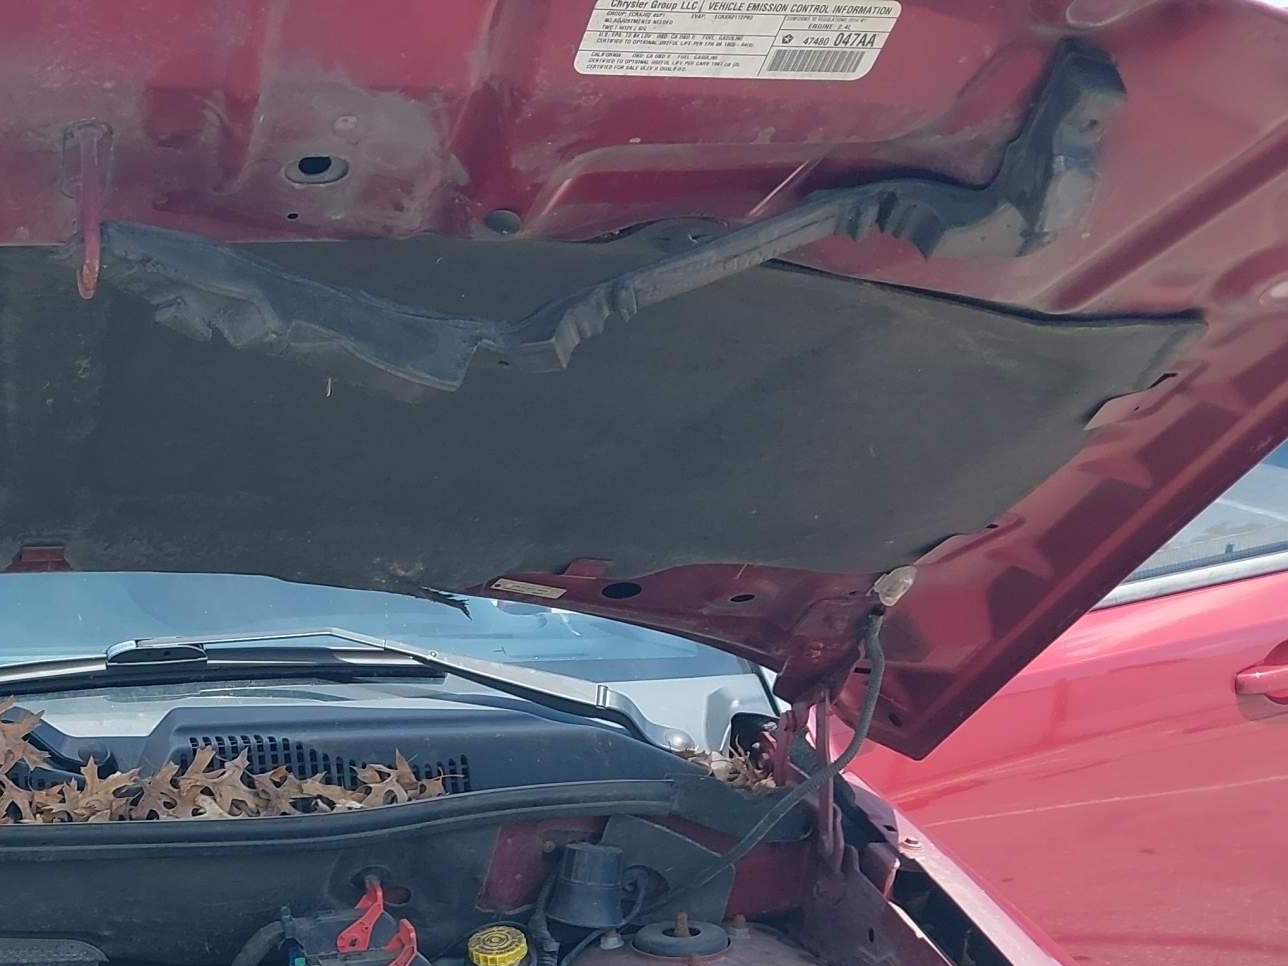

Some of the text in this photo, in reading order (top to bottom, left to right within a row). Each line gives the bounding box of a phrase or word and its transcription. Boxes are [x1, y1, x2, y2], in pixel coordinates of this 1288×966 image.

[610, 0, 698, 11] Chrysler Group LLC
[708, 2, 893, 16] VEHICLE EMISSION CONTROL INFORMATION
[802, 32, 877, 48] 47480 047AA
